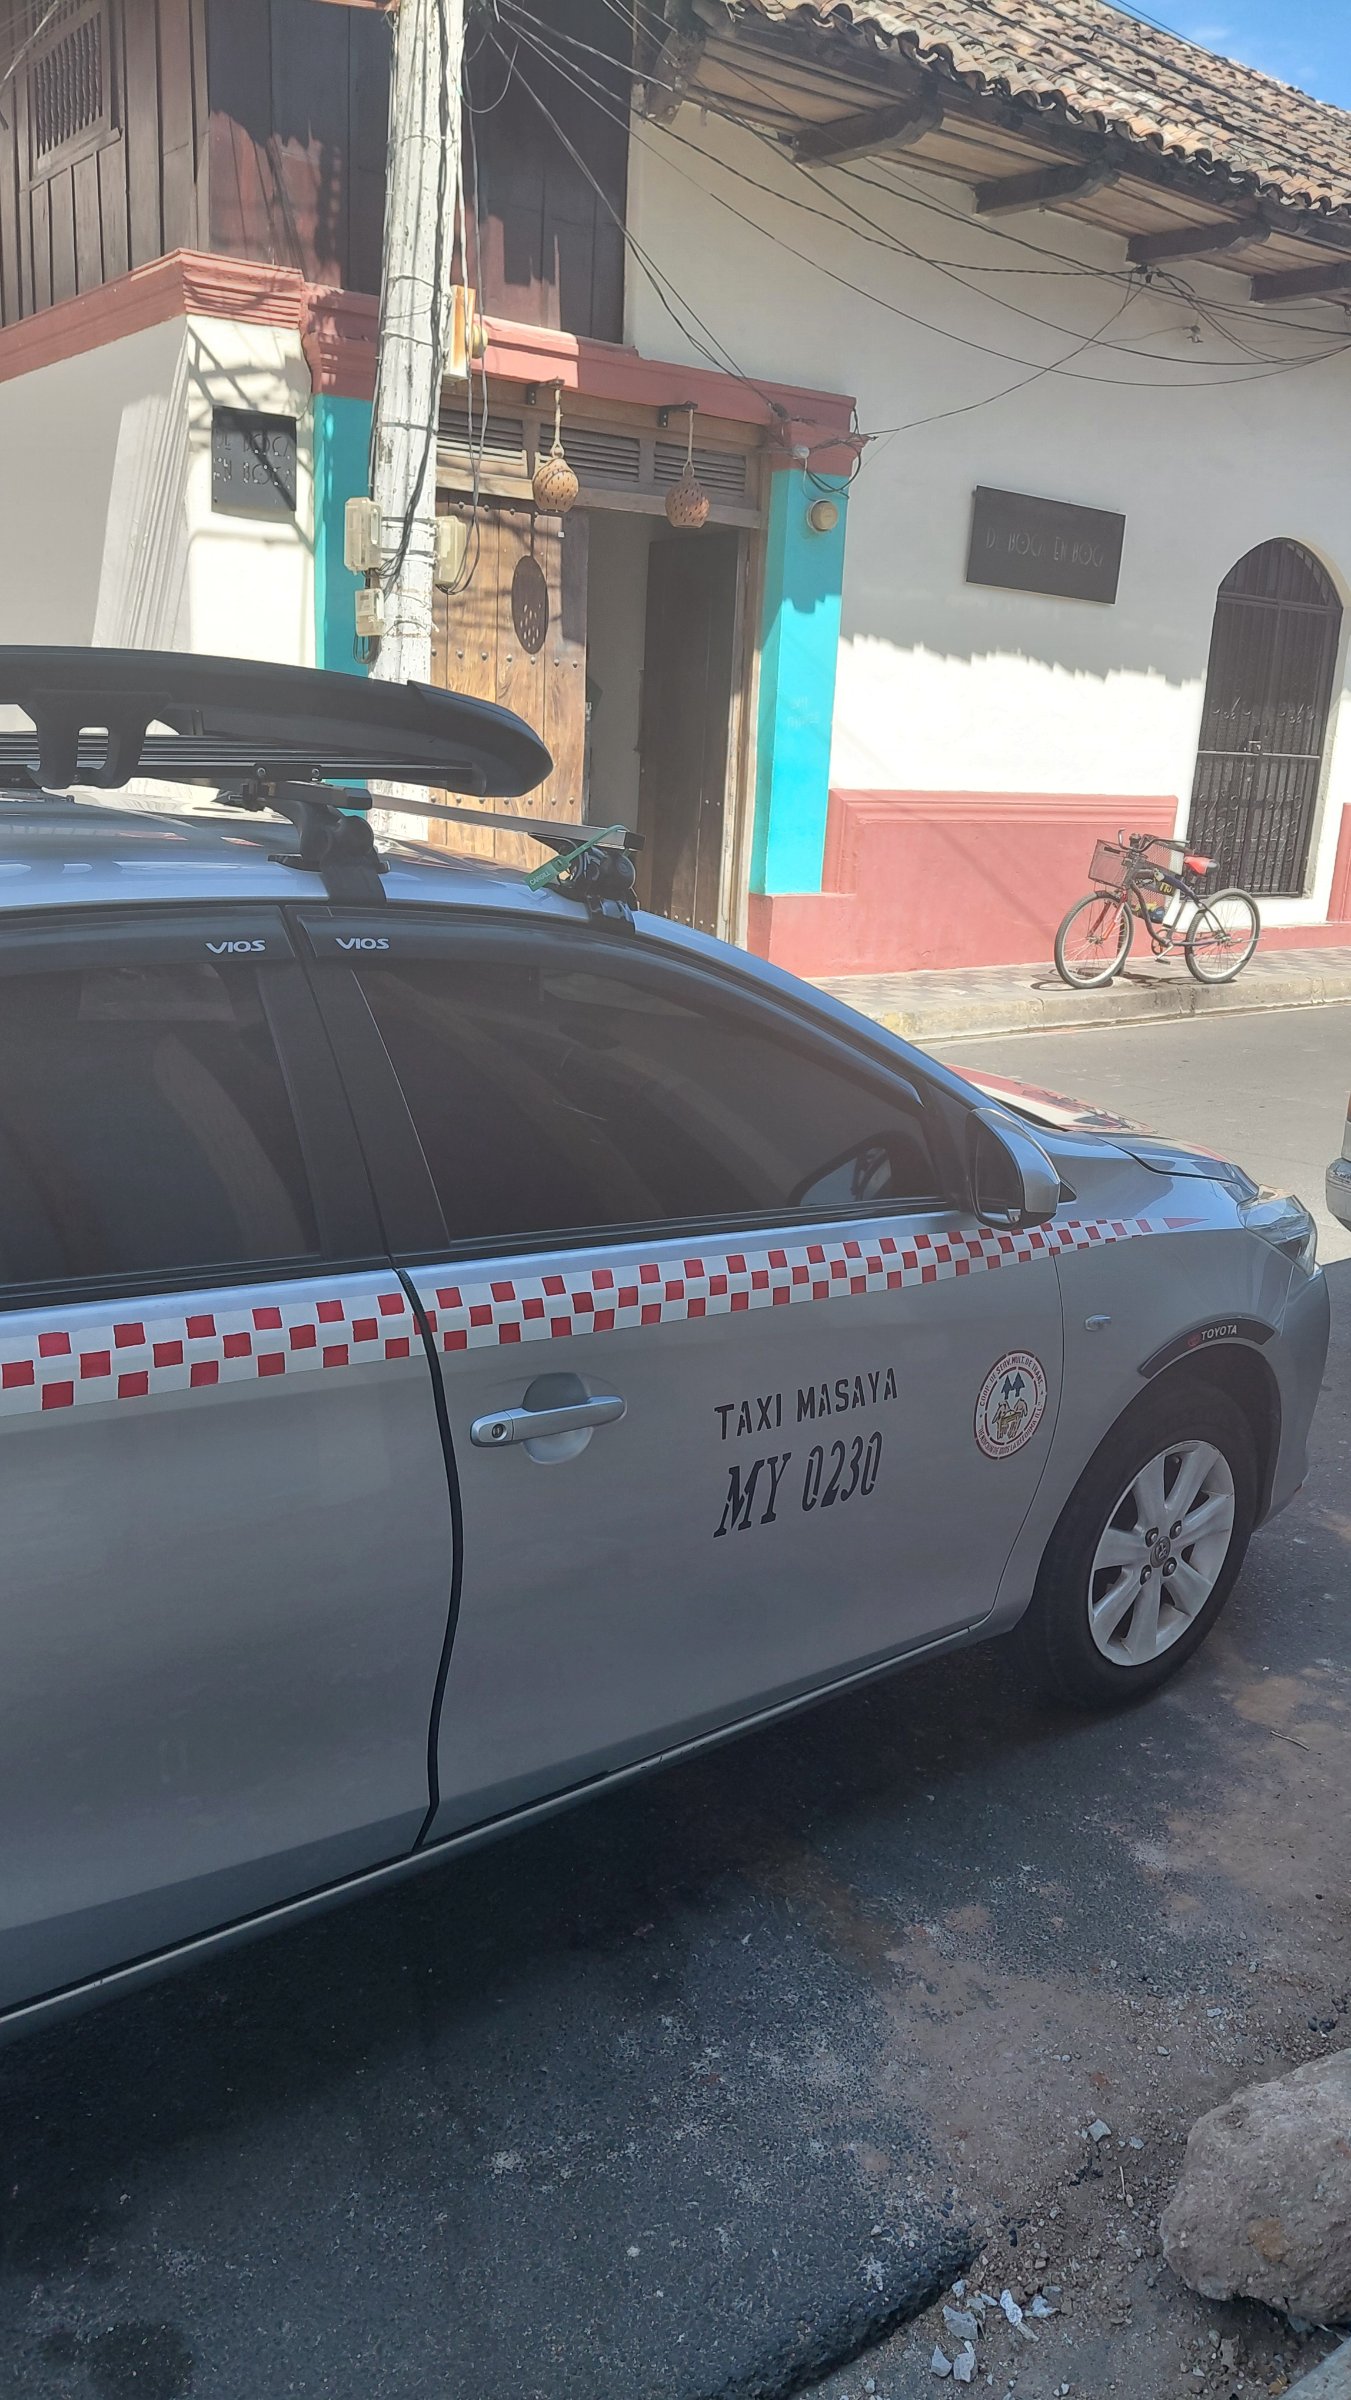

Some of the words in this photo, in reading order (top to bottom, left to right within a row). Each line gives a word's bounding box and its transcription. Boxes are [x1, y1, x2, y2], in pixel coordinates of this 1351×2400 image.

[204, 939, 266, 954] VIOS
[335, 937, 390, 950] VIOS
[1201, 1324, 1238, 1341] TOYOTA
[713, 1393, 783, 1440] TAXI
[796, 1367, 898, 1423] MASAYA
[713, 1451, 792, 1538] MY
[801, 1431, 883, 1512] 0230
